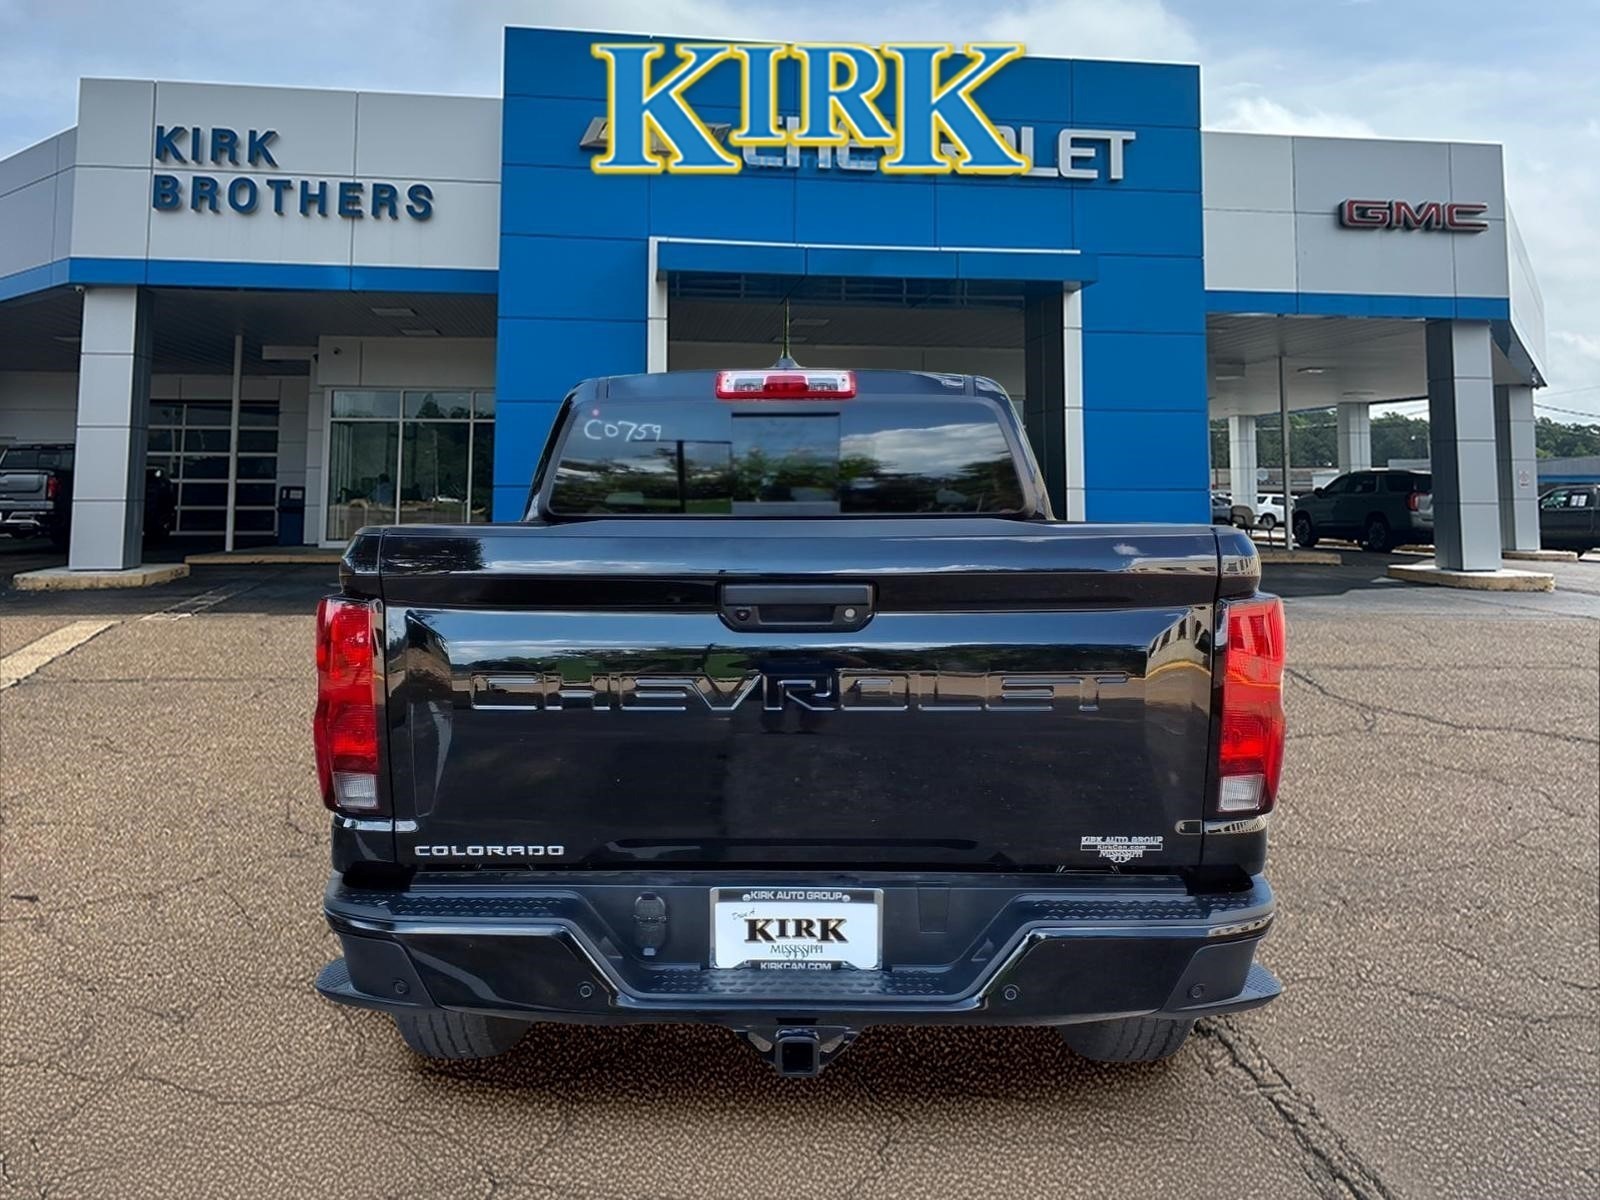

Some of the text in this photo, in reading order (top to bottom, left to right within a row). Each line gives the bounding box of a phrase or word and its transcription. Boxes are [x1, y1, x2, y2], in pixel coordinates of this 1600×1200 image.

[155, 125, 280, 168] KIRK
[152, 174, 434, 221] BROTHERS
[1338, 198, 1488, 231] GMC
[471, 672, 1128, 712] CHEVROLET
[1081, 836, 1163, 844] KIRK AUTO GROUP
[414, 845, 565, 856] COLORADO
[750, 890, 842, 900] KIRK AUTO GROUP
[744, 918, 848, 943] KIRK
[769, 944, 823, 958] MISSISSIPPI
[760, 961, 831, 970] KIRKCAN.COM
